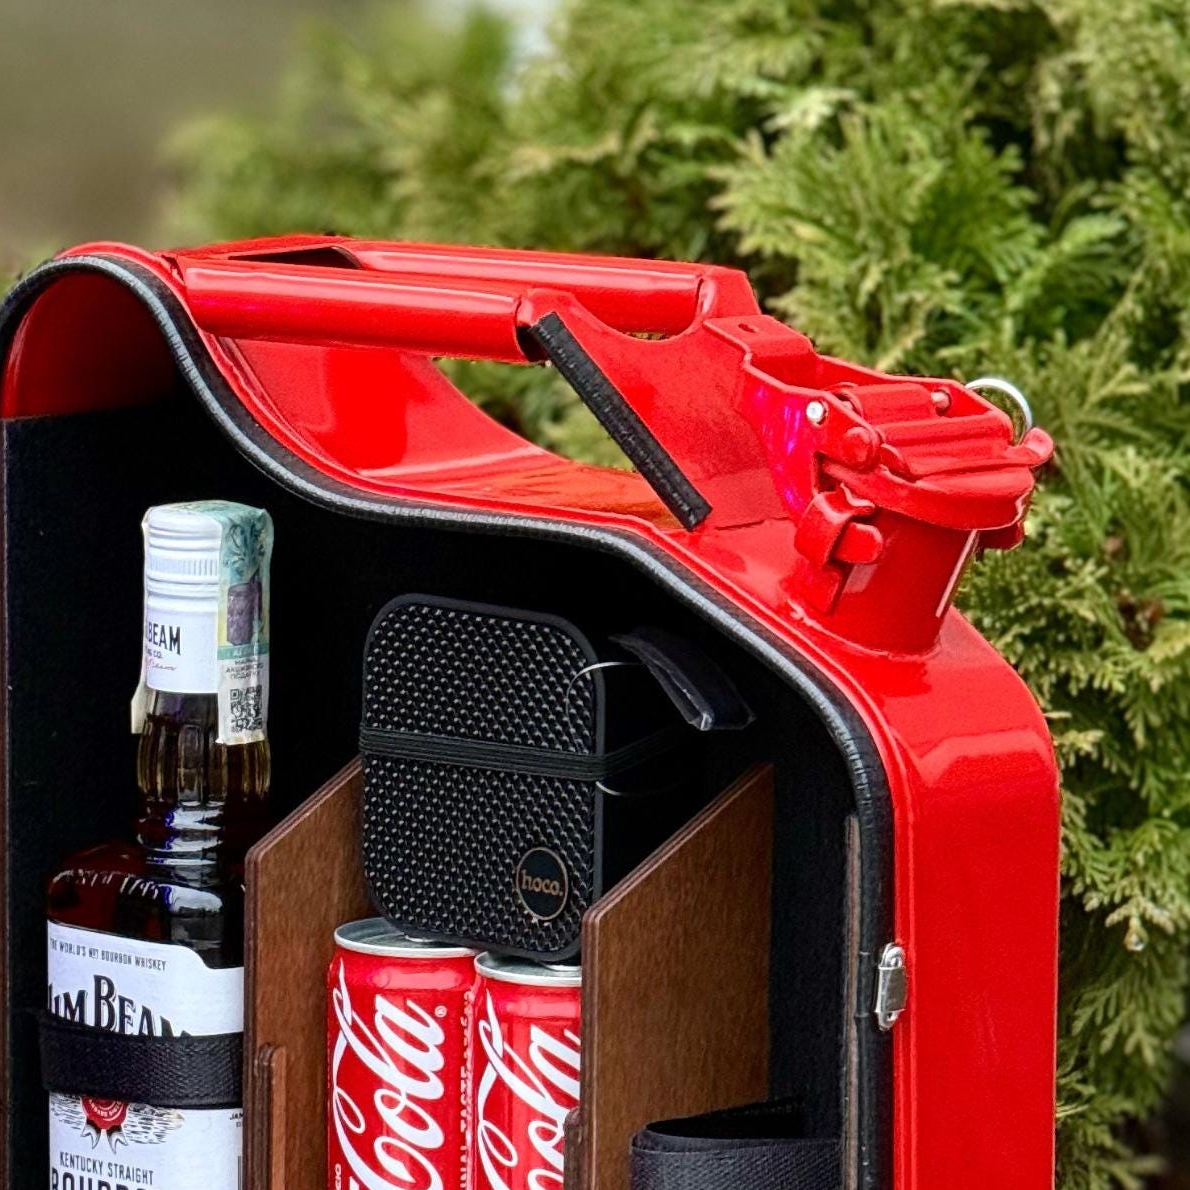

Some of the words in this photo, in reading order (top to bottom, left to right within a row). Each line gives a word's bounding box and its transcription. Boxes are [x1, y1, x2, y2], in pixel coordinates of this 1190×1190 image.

[101, 949, 133, 966] BOURBON
[135, 956, 166, 972] WHISKEY
[94, 974, 192, 1039] BEA
[60, 1151, 103, 1177] KENTUCKY
[107, 1162, 154, 1186] STRAIGHT
